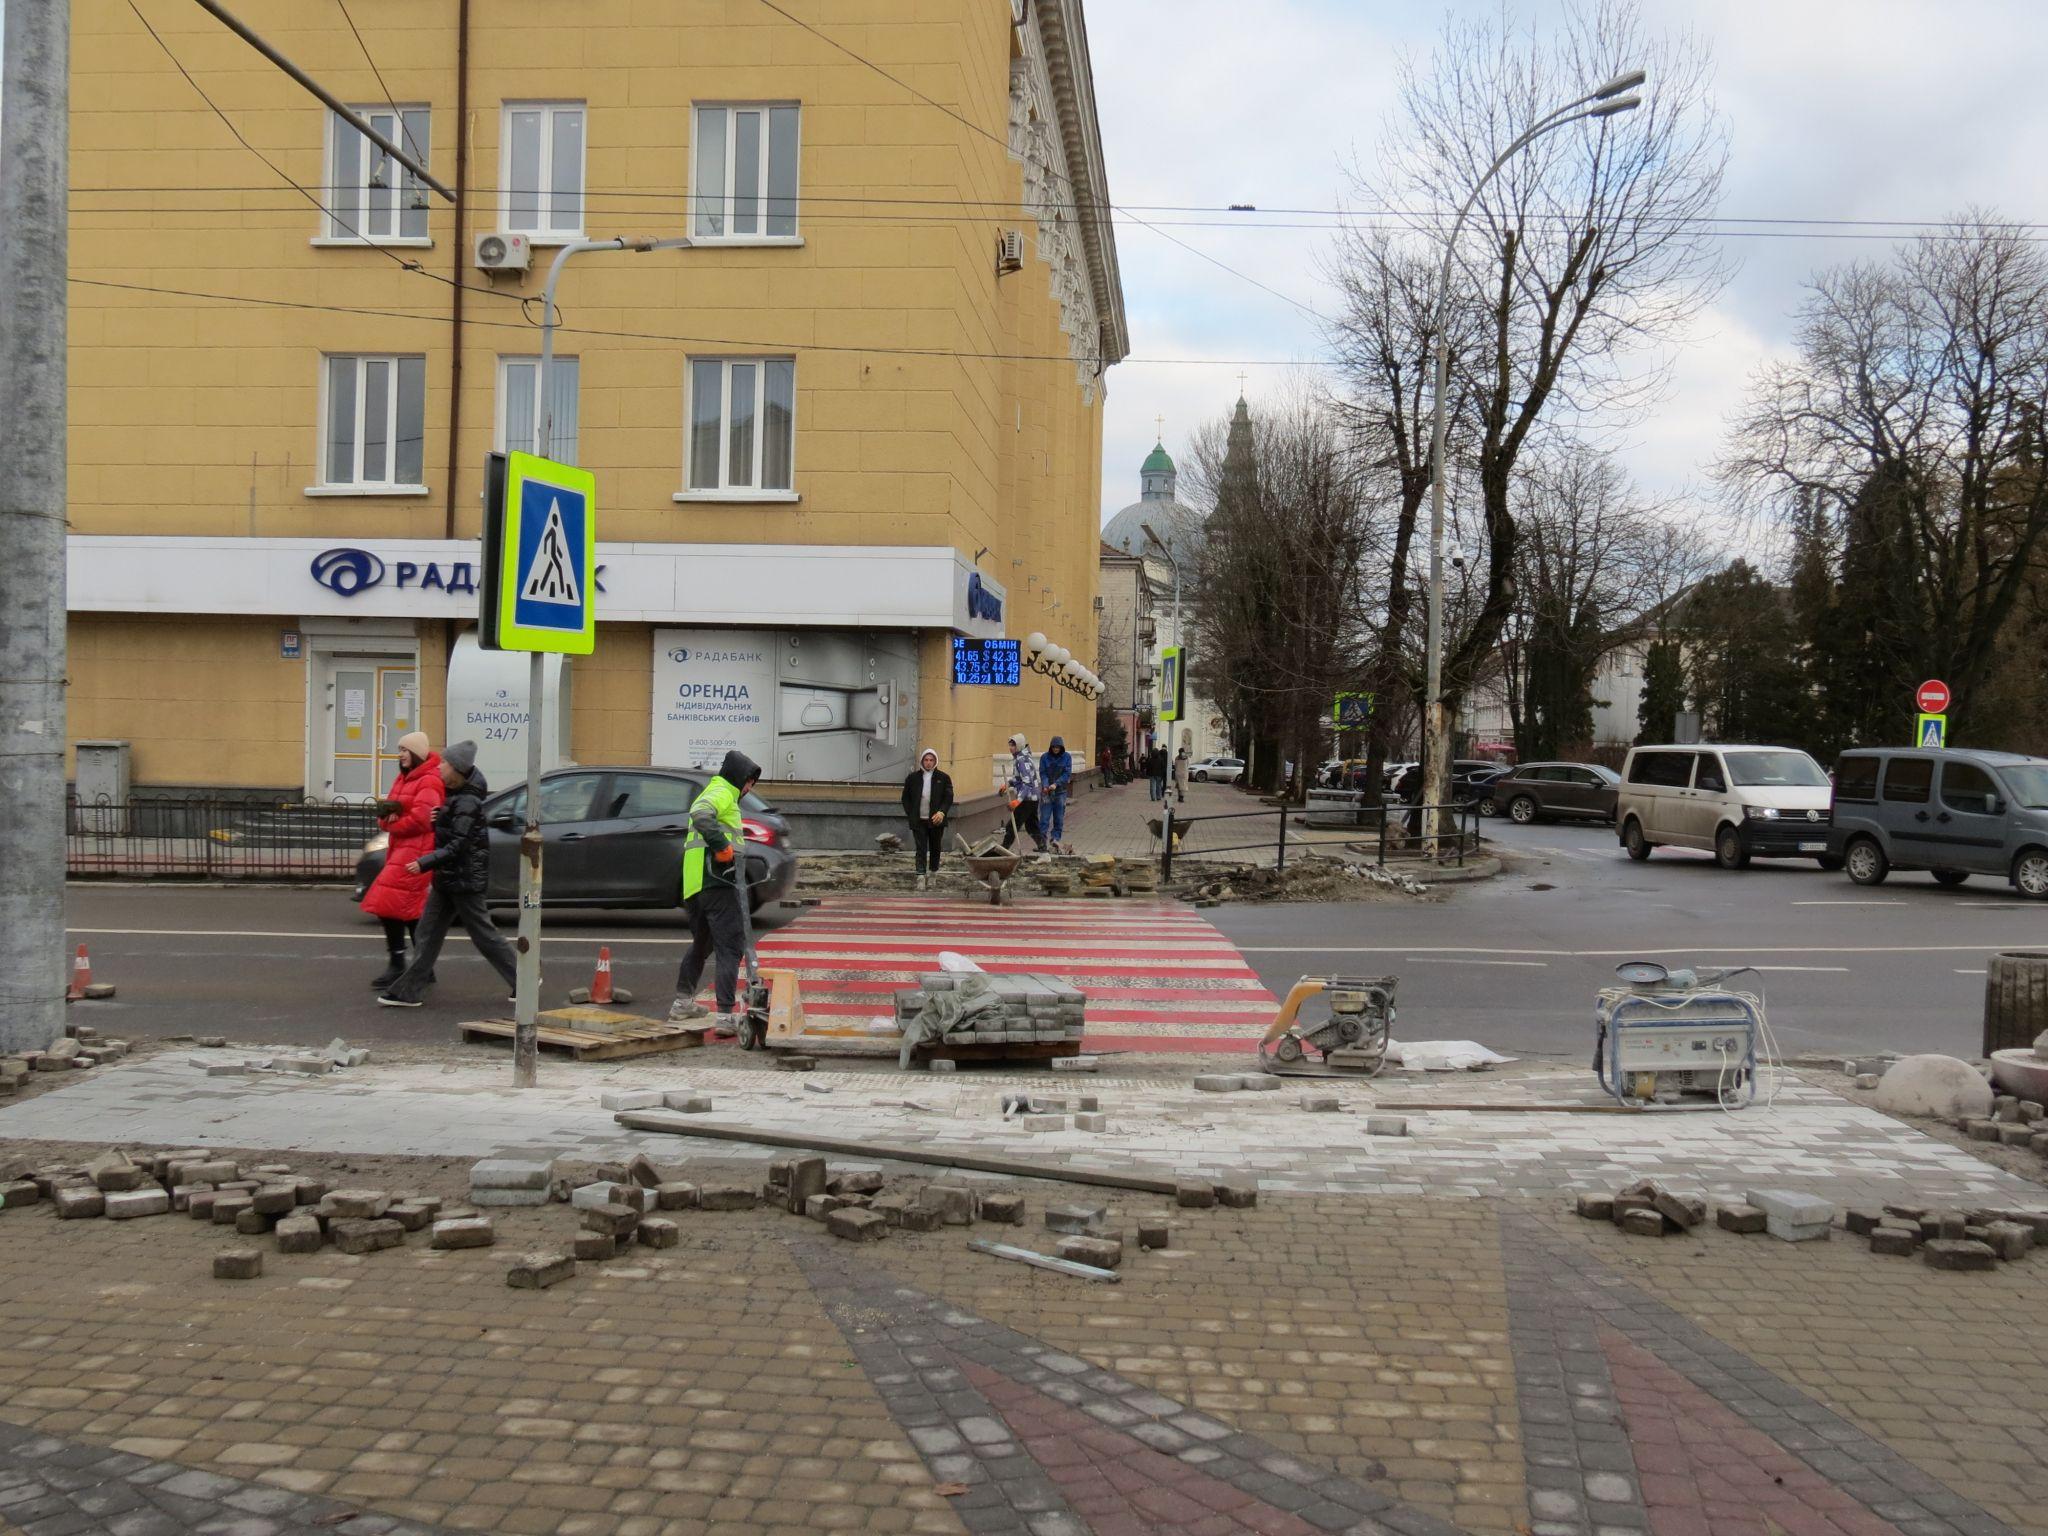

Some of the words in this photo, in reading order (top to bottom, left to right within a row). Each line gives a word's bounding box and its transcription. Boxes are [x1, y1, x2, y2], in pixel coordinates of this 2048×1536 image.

[984, 640, 1017, 649] ОБМІН
[695, 652, 762, 662] РАДАБАНК
[955, 650, 979, 662] 41.65
[982, 650, 990, 662] $
[992, 651, 1018, 662] 42.30
[954, 662, 980, 673] 43.75
[992, 662, 1019, 673] 44.45
[957, 673, 980, 684] 10.25
[995, 673, 1019, 685] 10.45
[679, 684, 749, 701] ОРЕНДА
[675, 702, 752, 711] ІНДИВІДУАЛЬНИХ
[467, 712, 531, 724] БАНКОМА
[667, 713, 726, 722] БАНКІВСЬКИХ
[728, 714, 760, 723] СЕЙФІВ
[485, 727, 518, 741] 24/7
